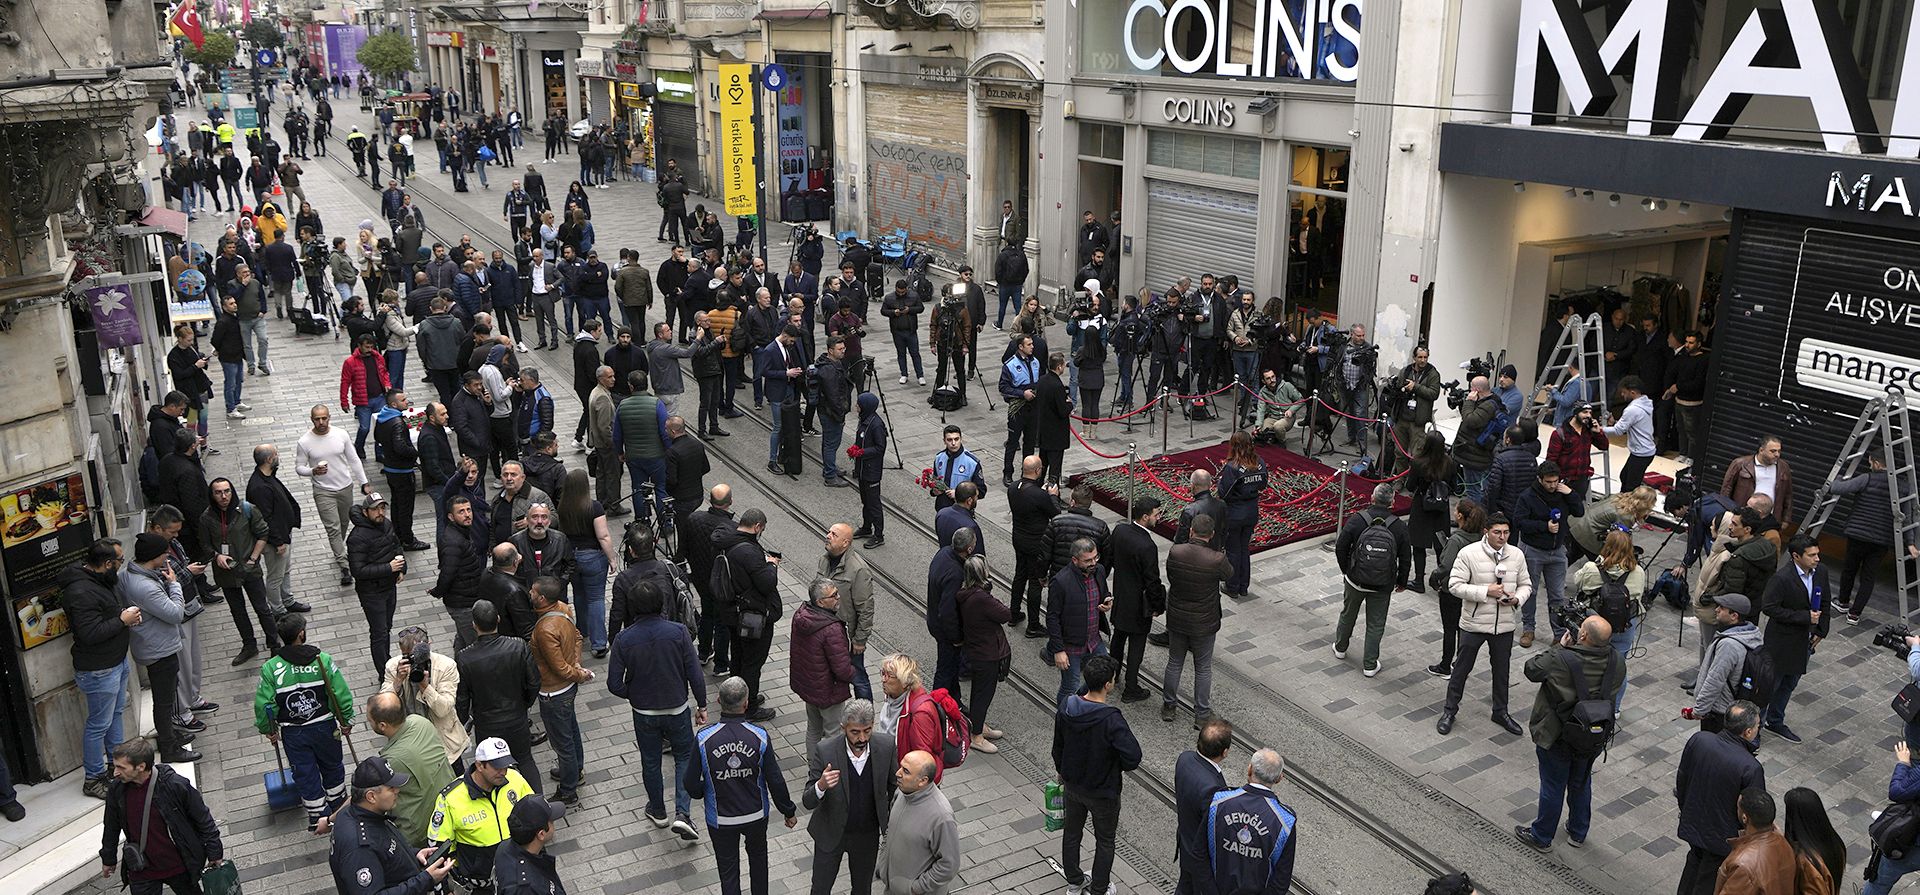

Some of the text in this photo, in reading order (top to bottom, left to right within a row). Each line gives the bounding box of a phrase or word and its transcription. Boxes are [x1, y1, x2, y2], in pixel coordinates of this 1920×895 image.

[1124, 0, 1362, 82] COLIN'S
[1162, 98, 1235, 127] COLIN'S
[780, 134, 804, 148] GÜMÜŞ
[1825, 170, 1920, 217] MA
[1824, 291, 1920, 328] ALIŞVE
[291, 664, 319, 676] istaç
[712, 740, 756, 759] BEYOĞLU
[715, 768, 753, 780] ZABITA
[462, 809, 488, 826] POLİS
[1224, 812, 1270, 836] BEYOĞLU
[1222, 838, 1263, 859] ZABITA
